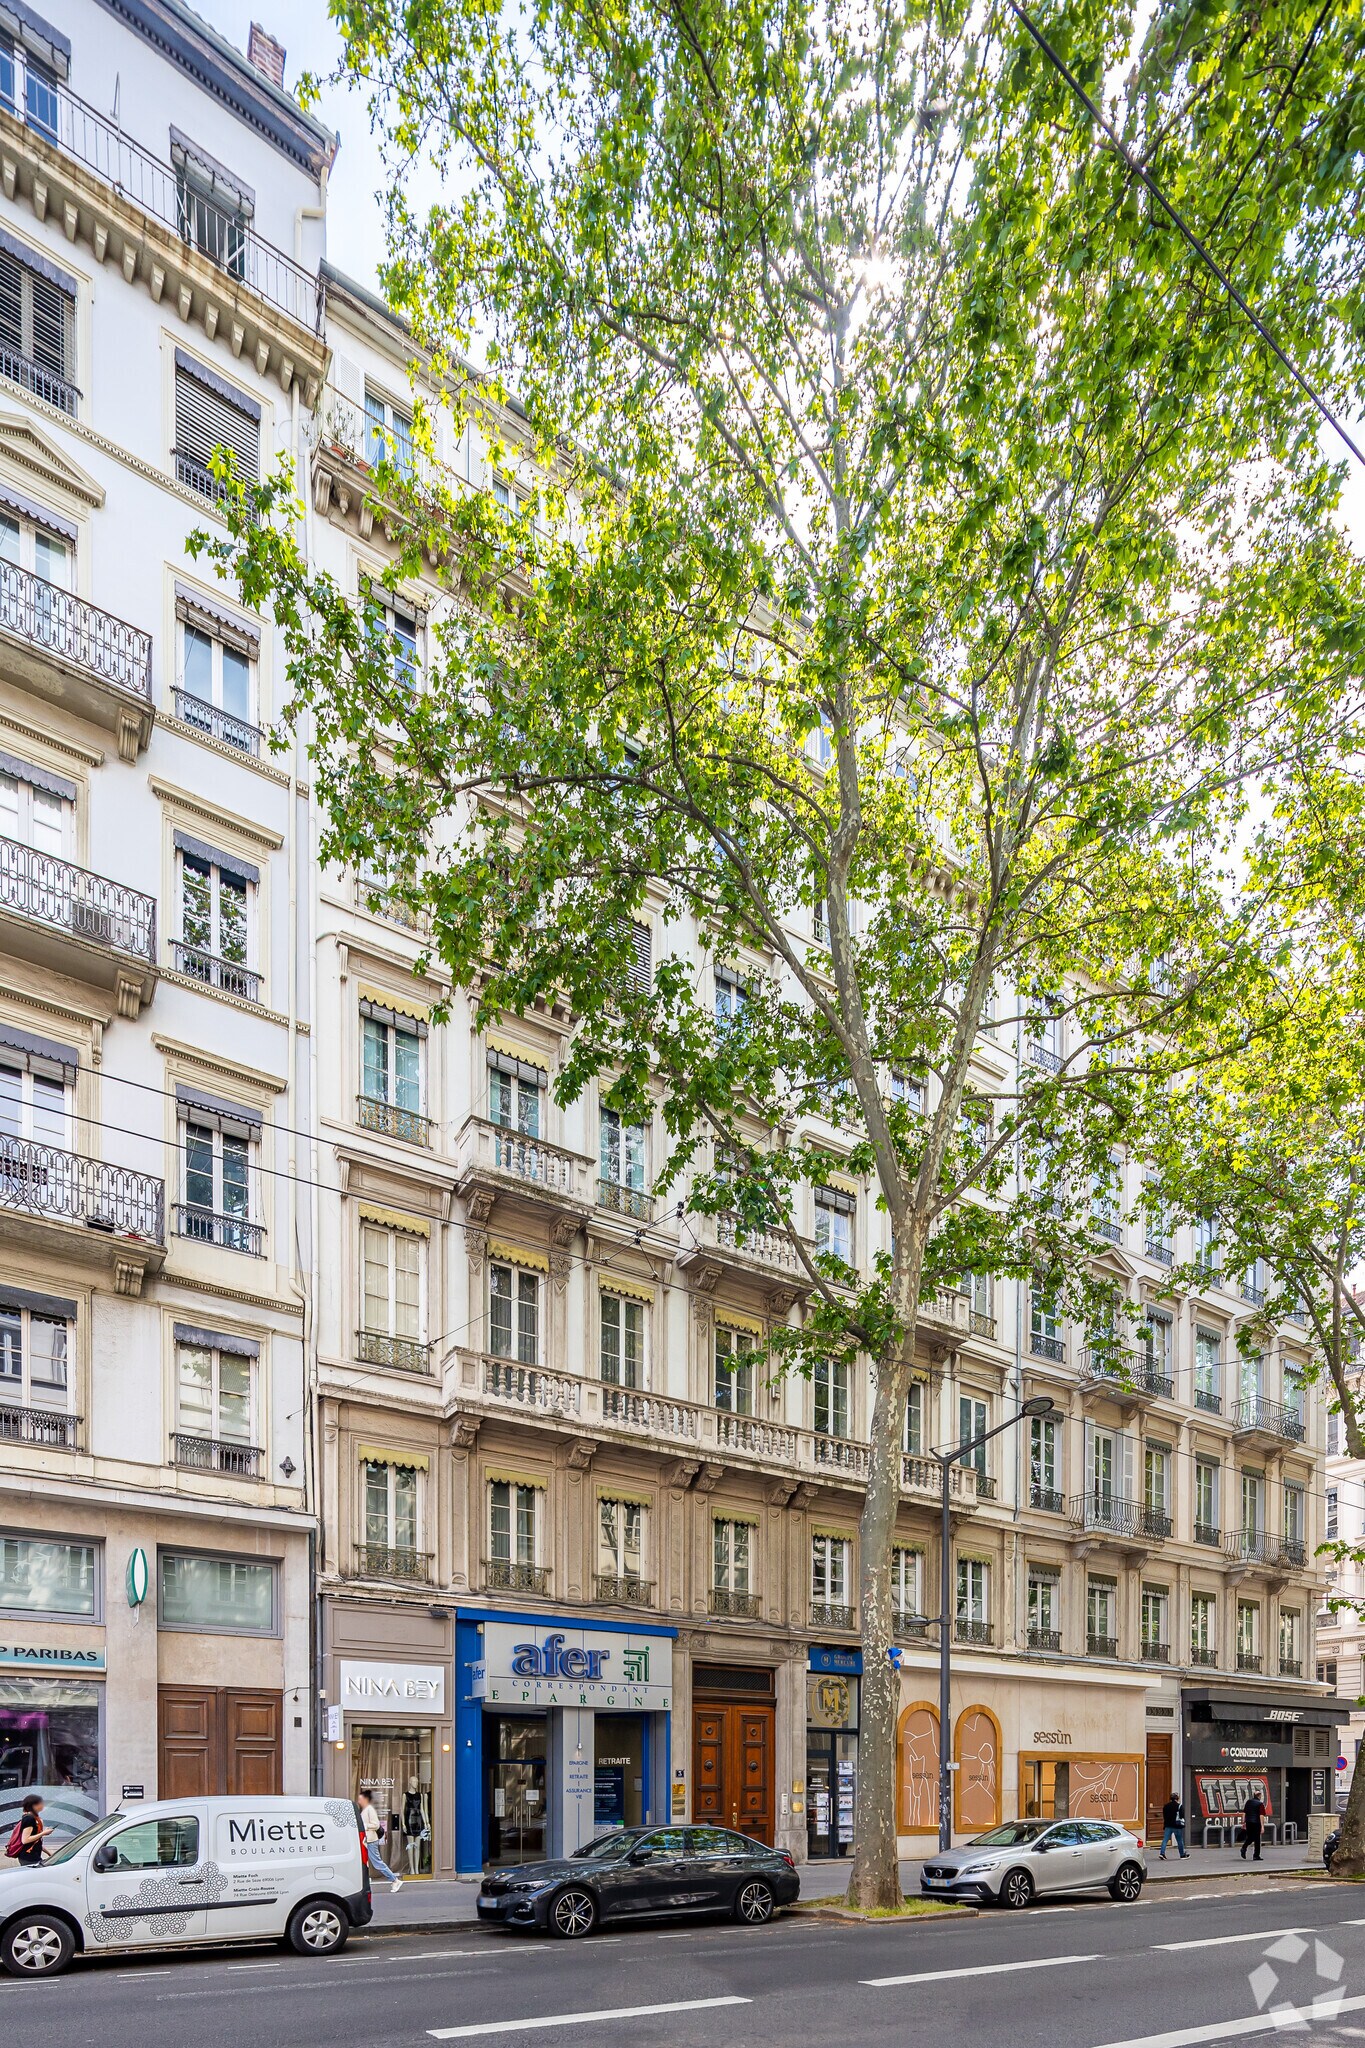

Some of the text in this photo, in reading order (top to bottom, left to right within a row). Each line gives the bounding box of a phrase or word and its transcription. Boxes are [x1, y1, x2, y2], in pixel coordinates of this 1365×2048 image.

[13, 1647, 98, 1662] PARIBAS
[512, 1634, 610, 1680] afer
[472, 1666, 486, 1680] afer
[345, 1676, 440, 1699] NINA BEY
[512, 1680, 649, 1693] CORRESPONDANT
[492, 1690, 669, 1707] EPARGNE
[1264, 1710, 1304, 1721] BOSE
[1033, 1729, 1072, 1744] sessùn
[1230, 1747, 1268, 1758] CONNEXION
[598, 1757, 631, 1765] RETRAITE
[381, 1777, 395, 1786] BEY
[229, 1819, 325, 1842] Miette
[230, 1845, 327, 1856] BOULANGERIE
